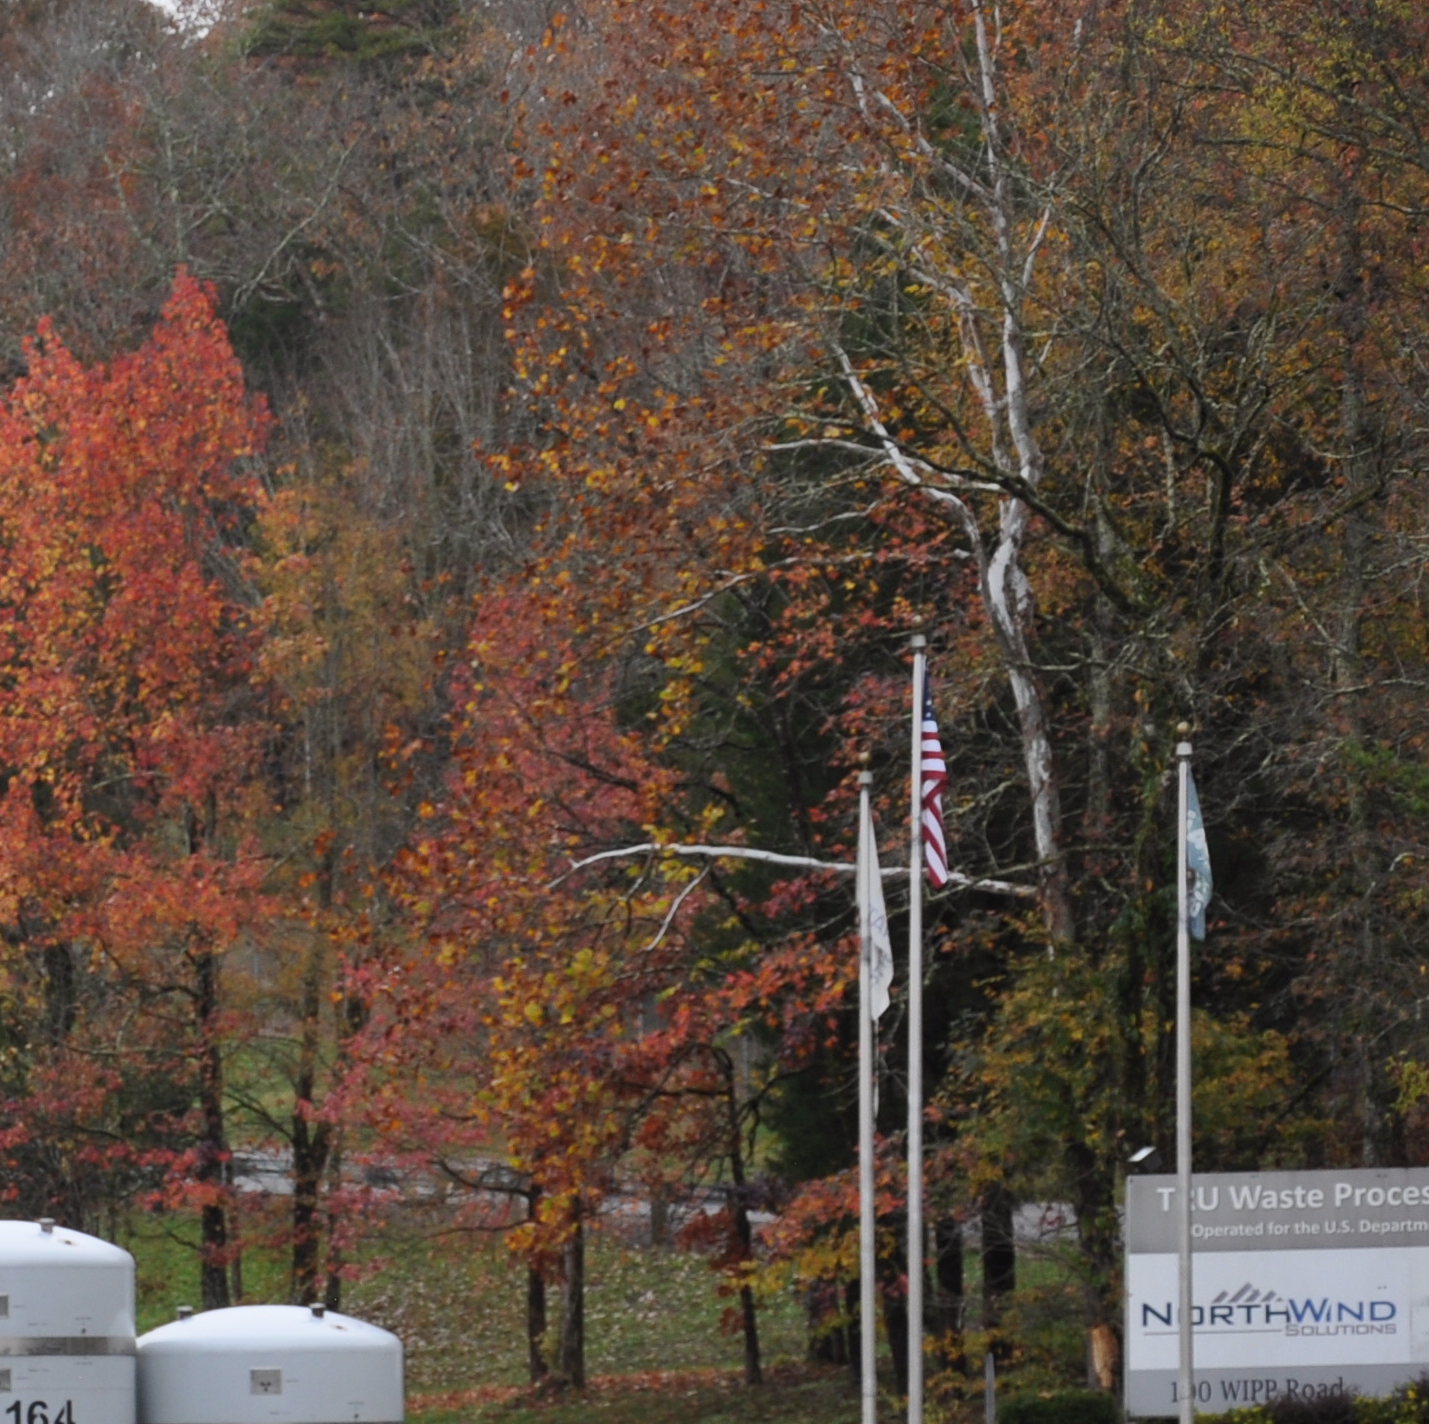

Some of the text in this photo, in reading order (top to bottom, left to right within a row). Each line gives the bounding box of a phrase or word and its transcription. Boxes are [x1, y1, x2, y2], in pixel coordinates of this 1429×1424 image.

[1229, 1184, 1324, 1210] Waste
[1192, 1223, 1263, 1238] Operated
[1269, 1222, 1291, 1235] for
[1295, 1220, 1321, 1235] the
[1325, 1220, 1355, 1234] U.S.
[1286, 1323, 1397, 1337] SOLUTIONS
[1221, 1378, 1278, 1401] WIPP
[1286, 1376, 1344, 1399] Road
